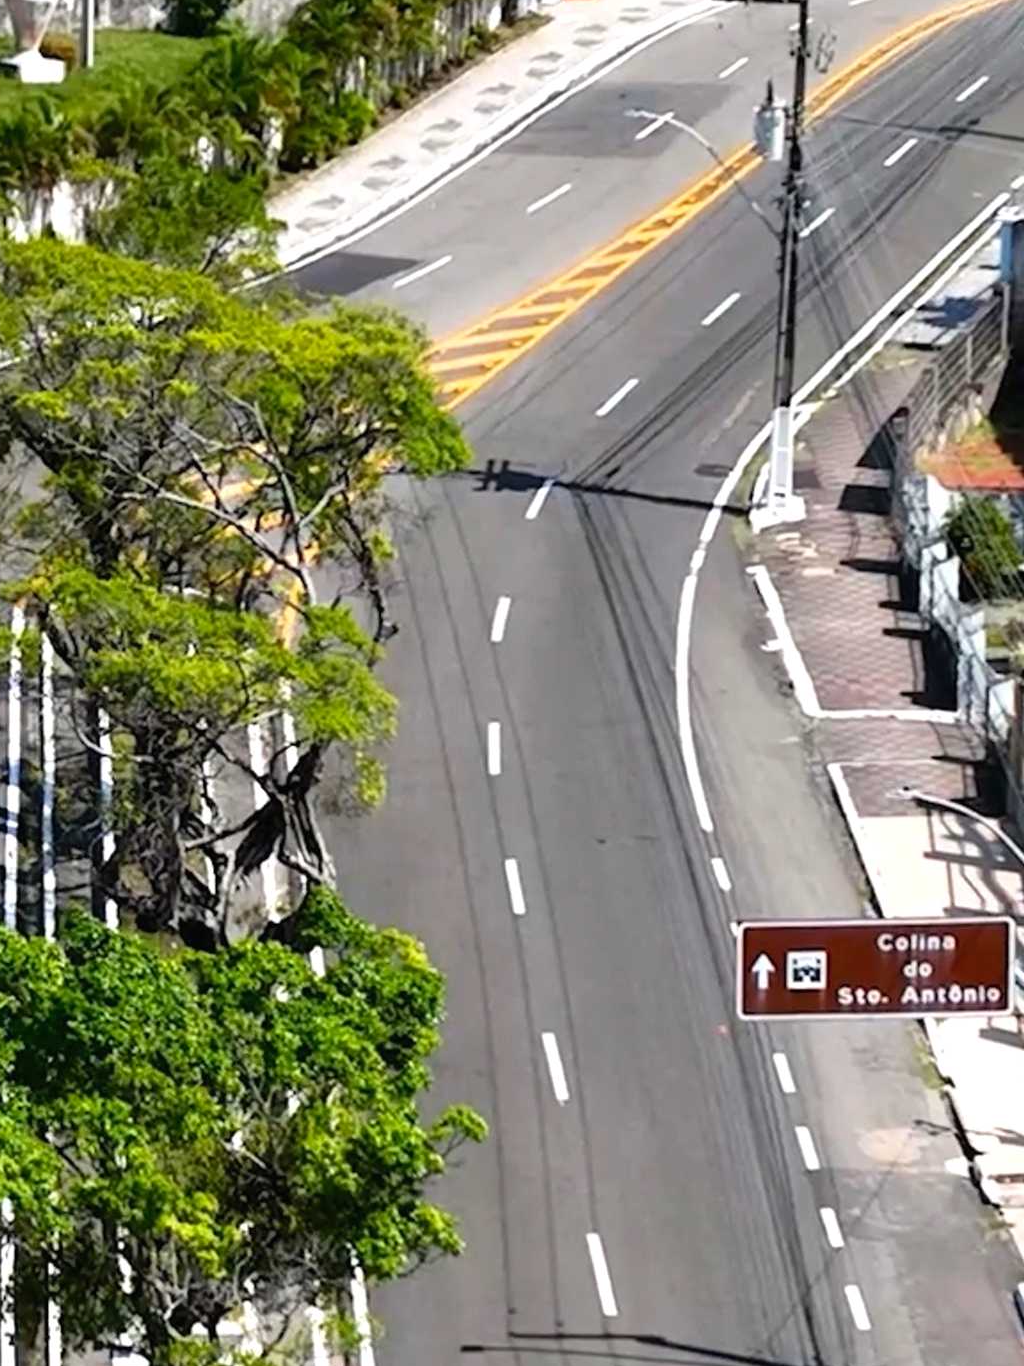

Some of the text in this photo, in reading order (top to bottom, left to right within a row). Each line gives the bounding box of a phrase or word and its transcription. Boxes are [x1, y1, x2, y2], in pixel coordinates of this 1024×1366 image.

[877, 933, 957, 953] Colina
[902, 959, 934, 979] do
[837, 982, 1001, 1005] Sto. Antônio
